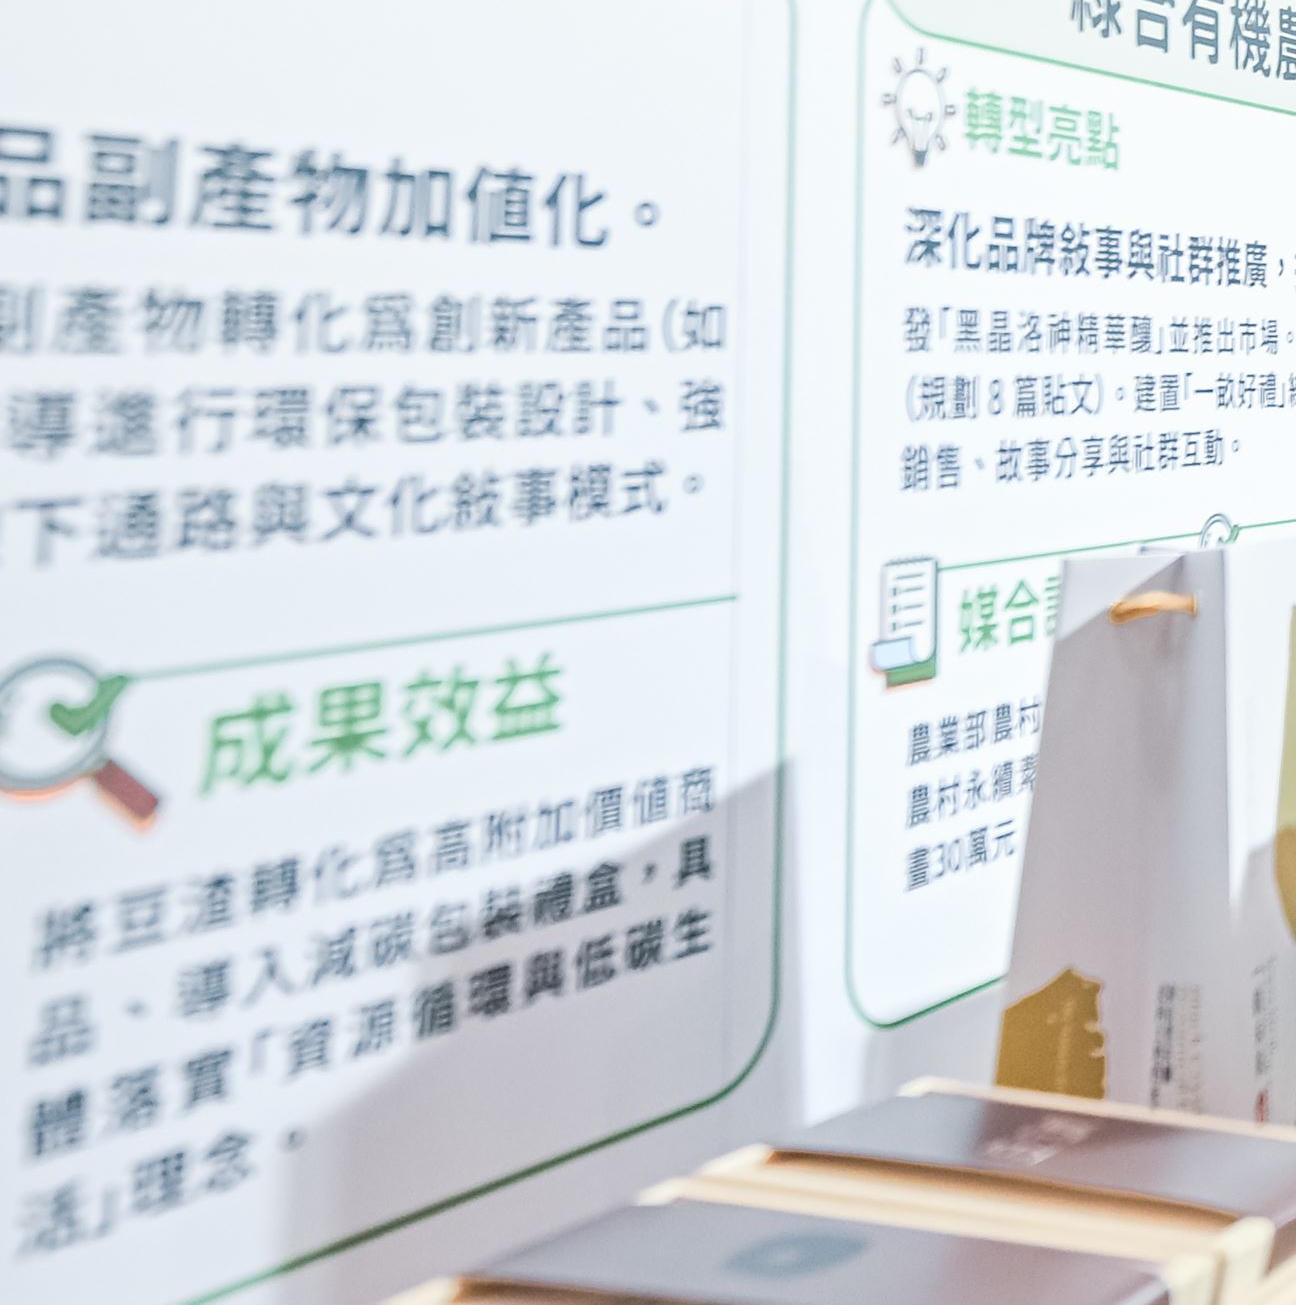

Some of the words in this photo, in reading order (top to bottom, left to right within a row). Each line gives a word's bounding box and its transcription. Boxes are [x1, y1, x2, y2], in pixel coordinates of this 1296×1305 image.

[962, 86, 1121, 171] 轉型亮點
[199, 651, 564, 795] 成果效益
